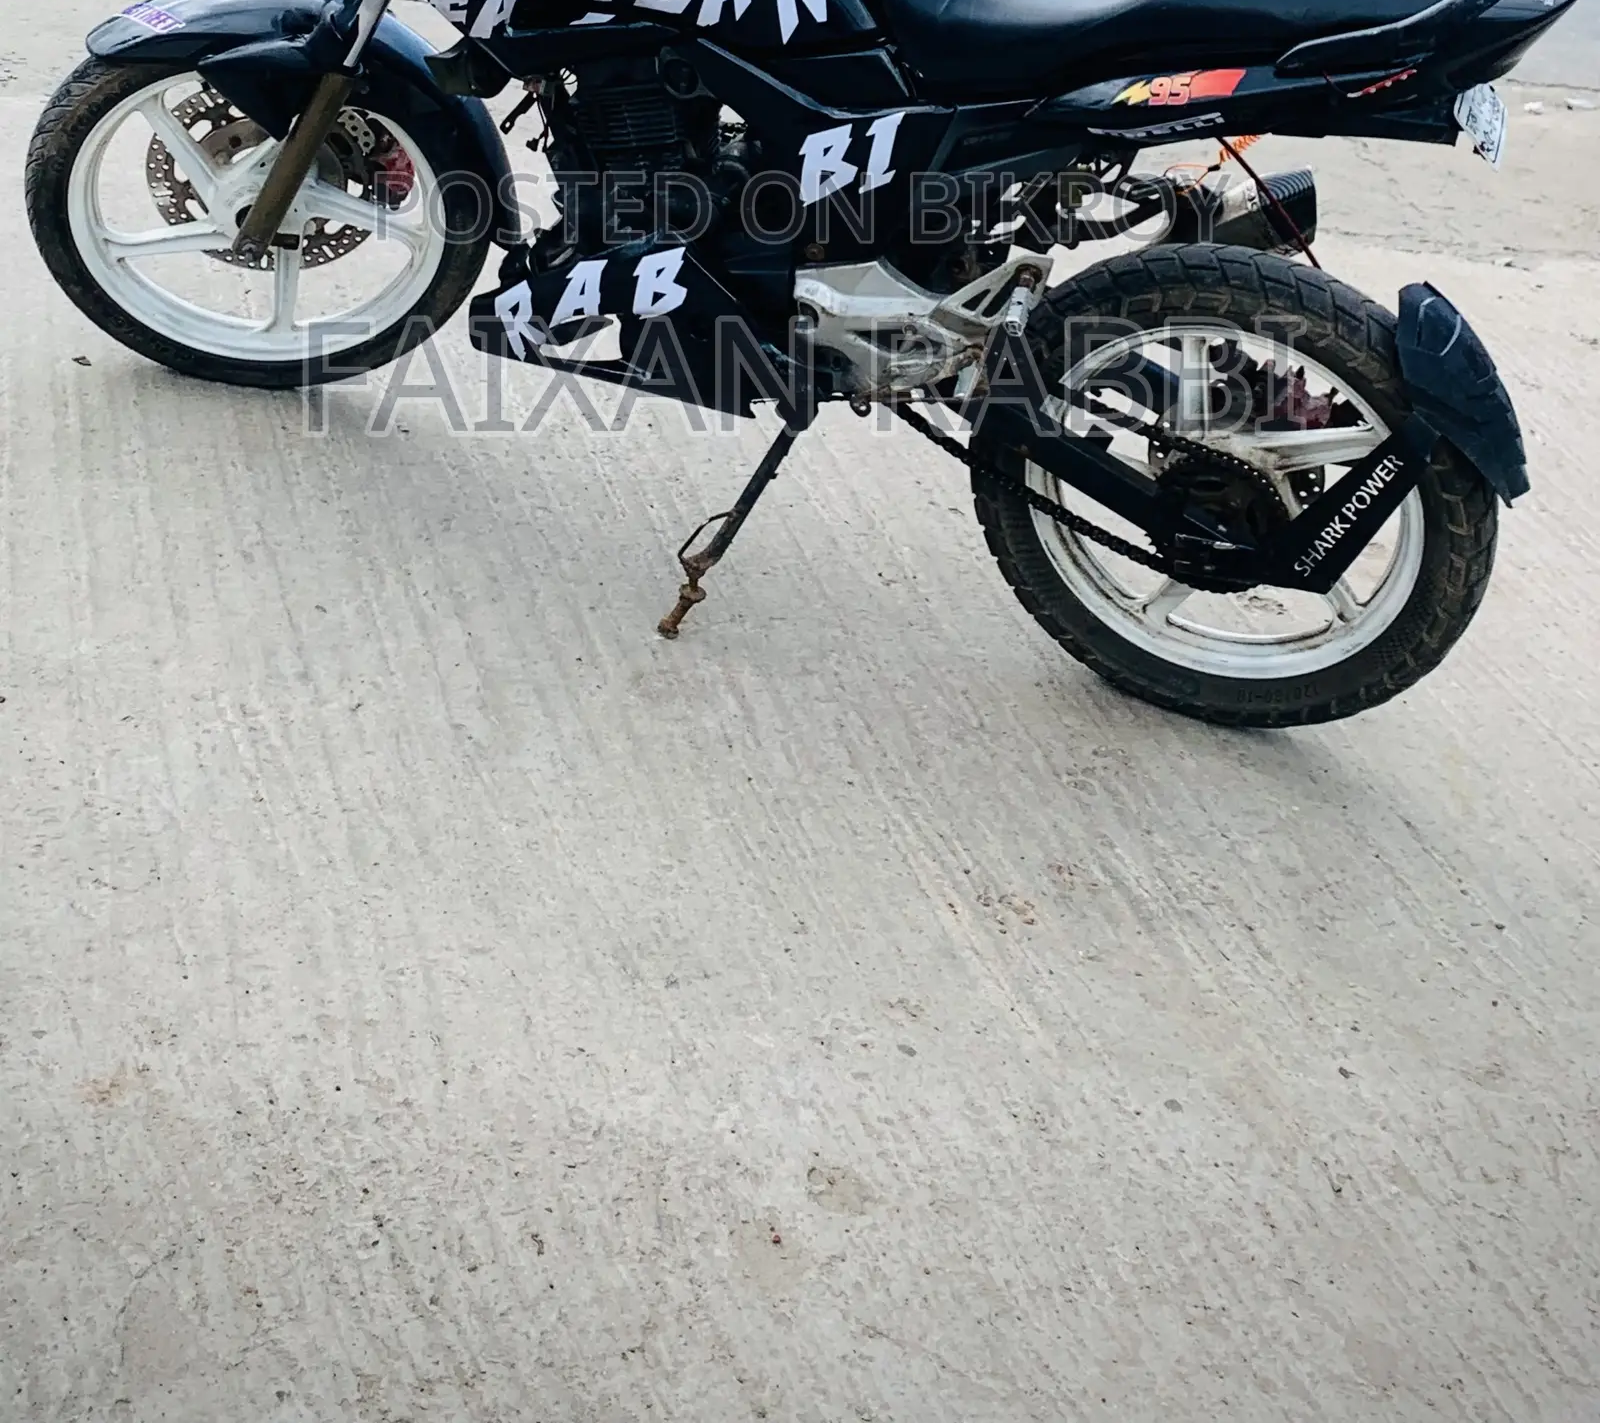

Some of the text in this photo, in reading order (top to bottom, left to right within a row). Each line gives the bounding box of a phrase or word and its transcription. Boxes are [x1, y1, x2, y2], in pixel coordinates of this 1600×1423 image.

[1148, 76, 1191, 106] 95
[494, 246, 688, 362] RAB
[1293, 454, 1404, 577] SHARK POWER
